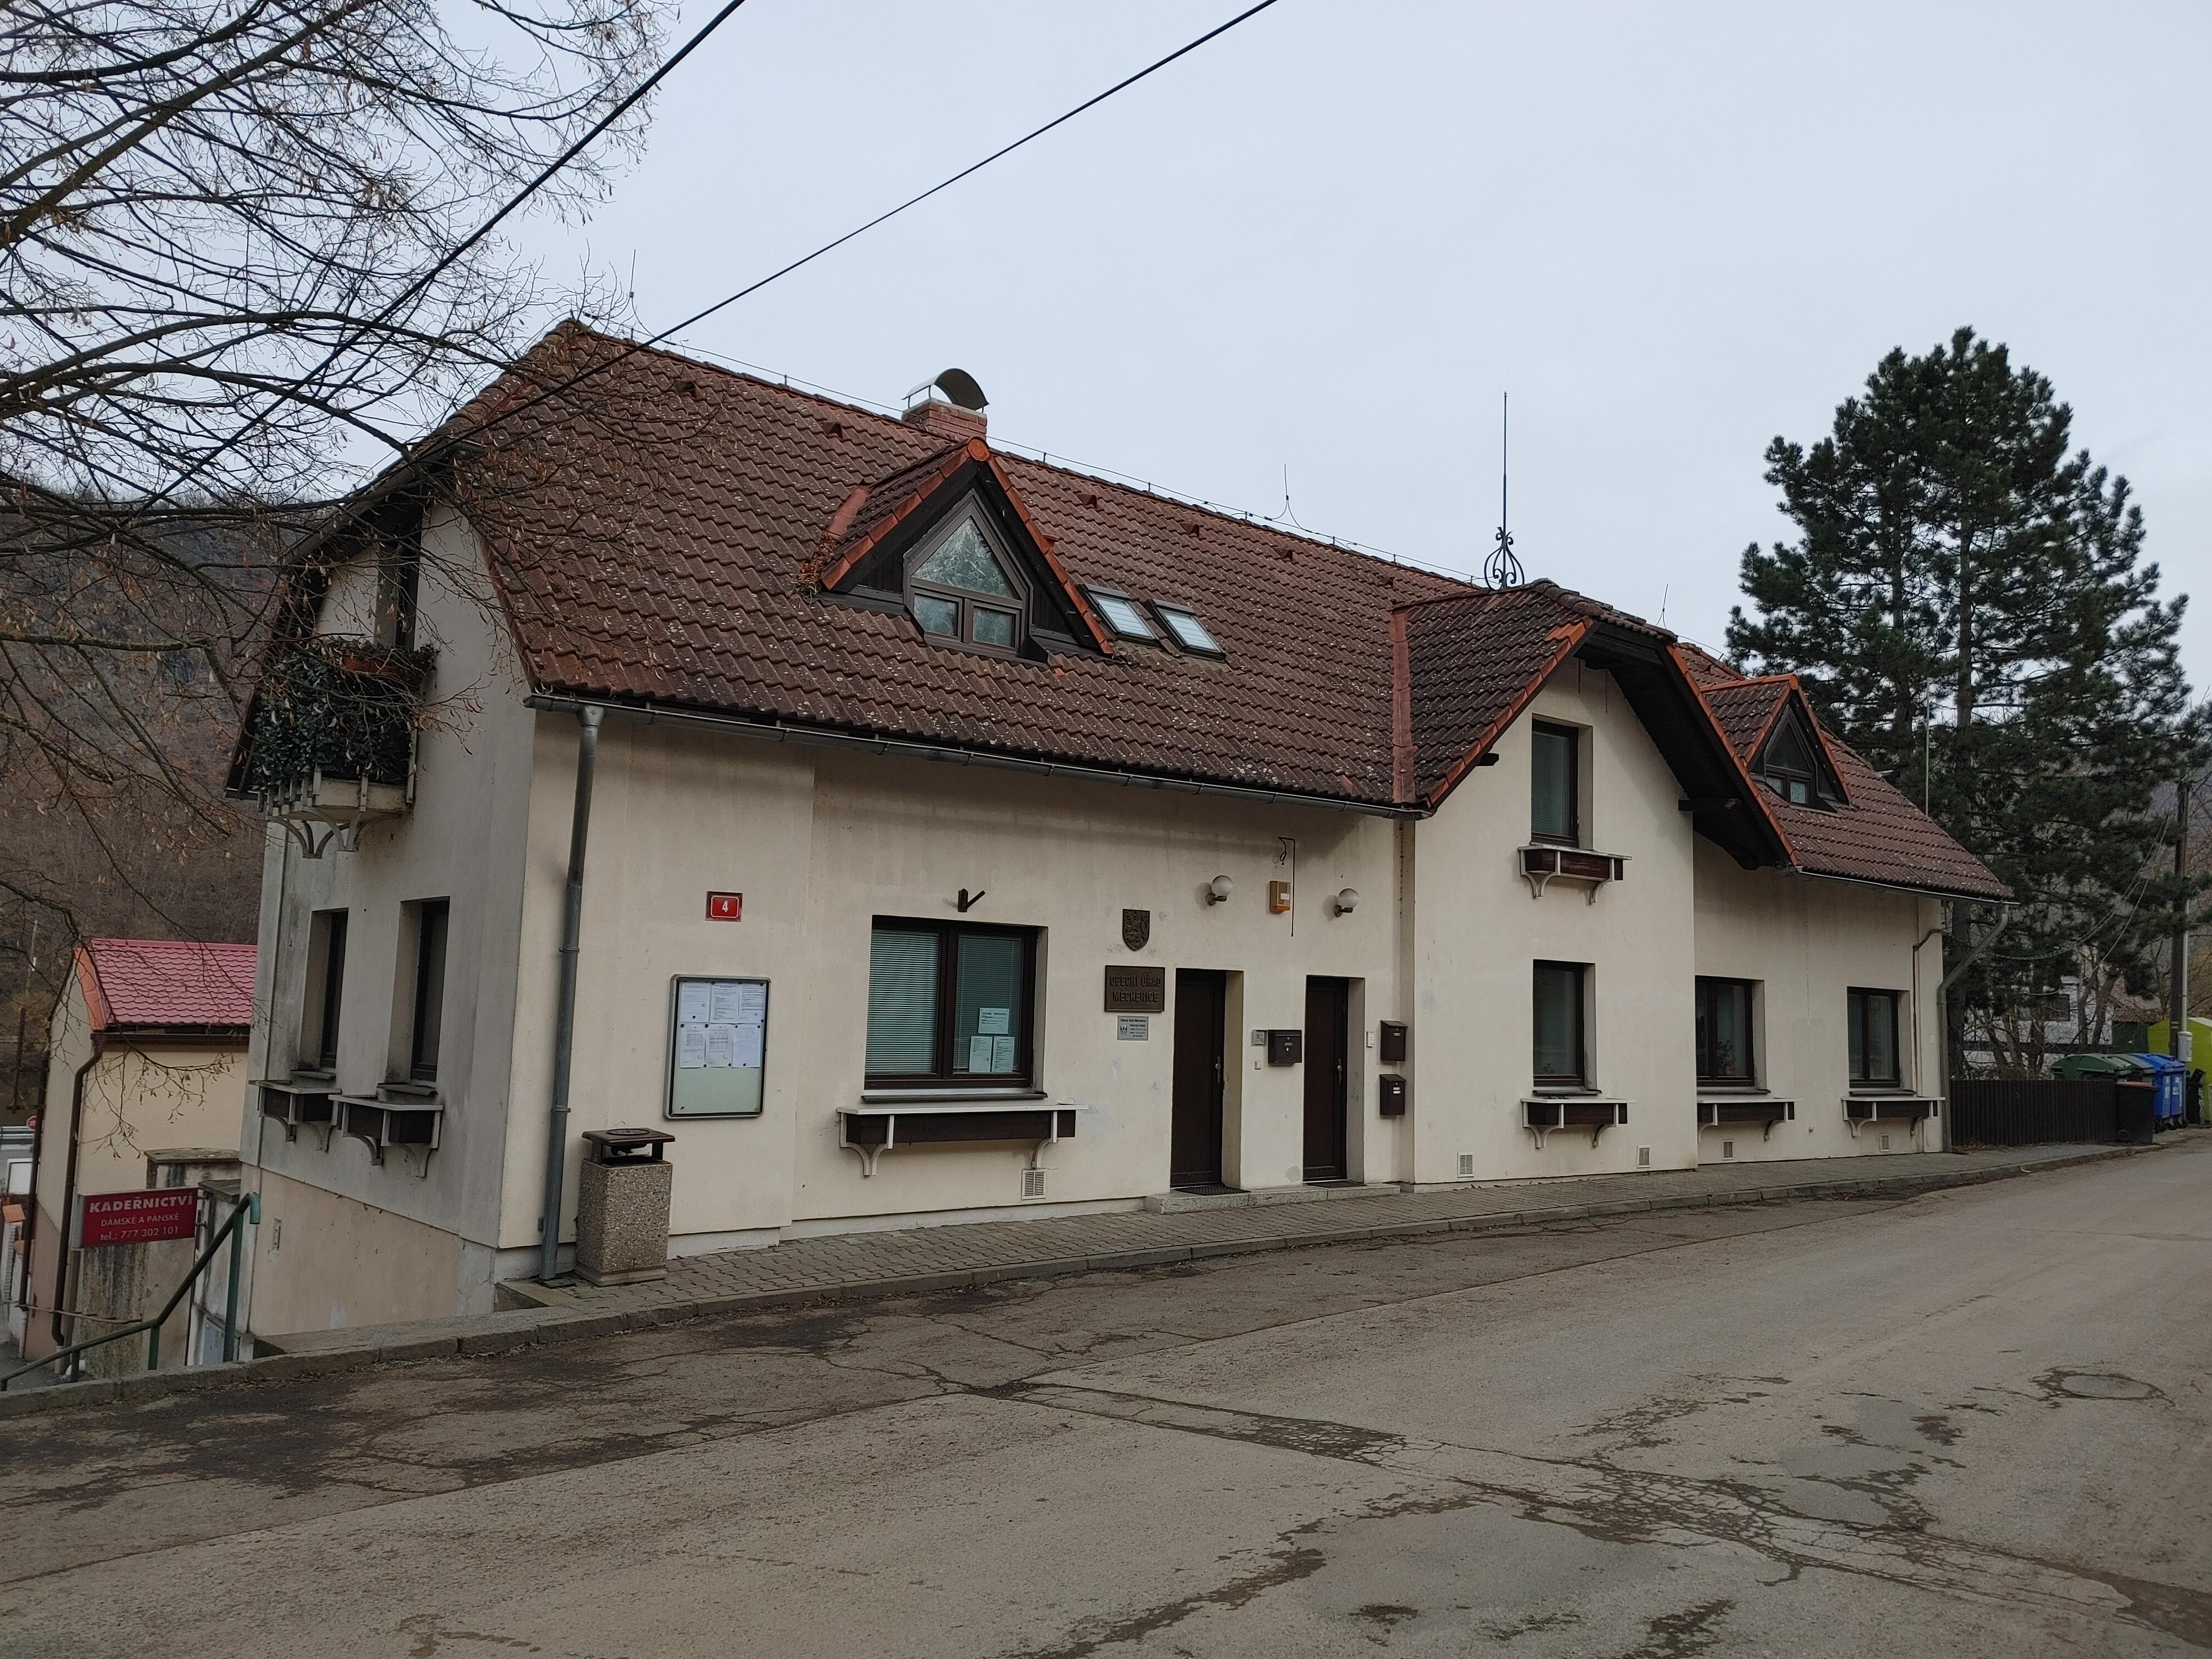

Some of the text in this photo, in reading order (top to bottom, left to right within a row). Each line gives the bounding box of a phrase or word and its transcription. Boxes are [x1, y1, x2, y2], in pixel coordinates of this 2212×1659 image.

[722, 900, 728, 912] 4
[1113, 989, 1159, 1003] MĚCHENICE
[90, 1193, 193, 1213] KADEŘNICTVÍ
[101, 1216, 136, 1227] DÁMSKÉ
[147, 1212, 179, 1222] PÁNSKÉ
[100, 1226, 179, 1240] tel.: 777 302 101
